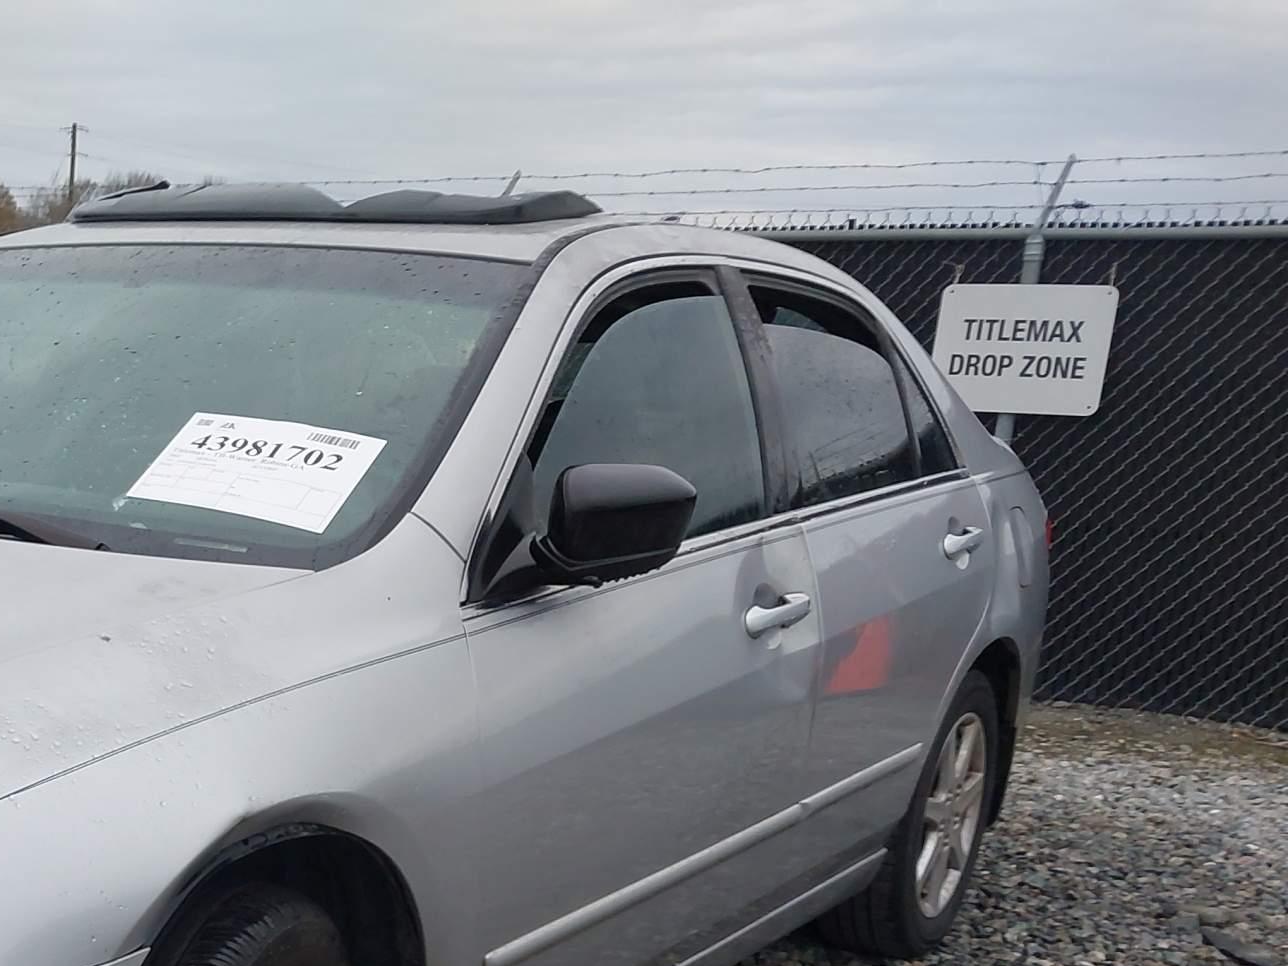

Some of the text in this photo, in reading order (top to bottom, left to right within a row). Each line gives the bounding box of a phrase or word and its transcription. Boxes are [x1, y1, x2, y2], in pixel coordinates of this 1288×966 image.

[963, 318, 1086, 343] TITLEMAX
[947, 353, 1088, 380] DROP ZONE
[190, 433, 344, 472] 43981702
